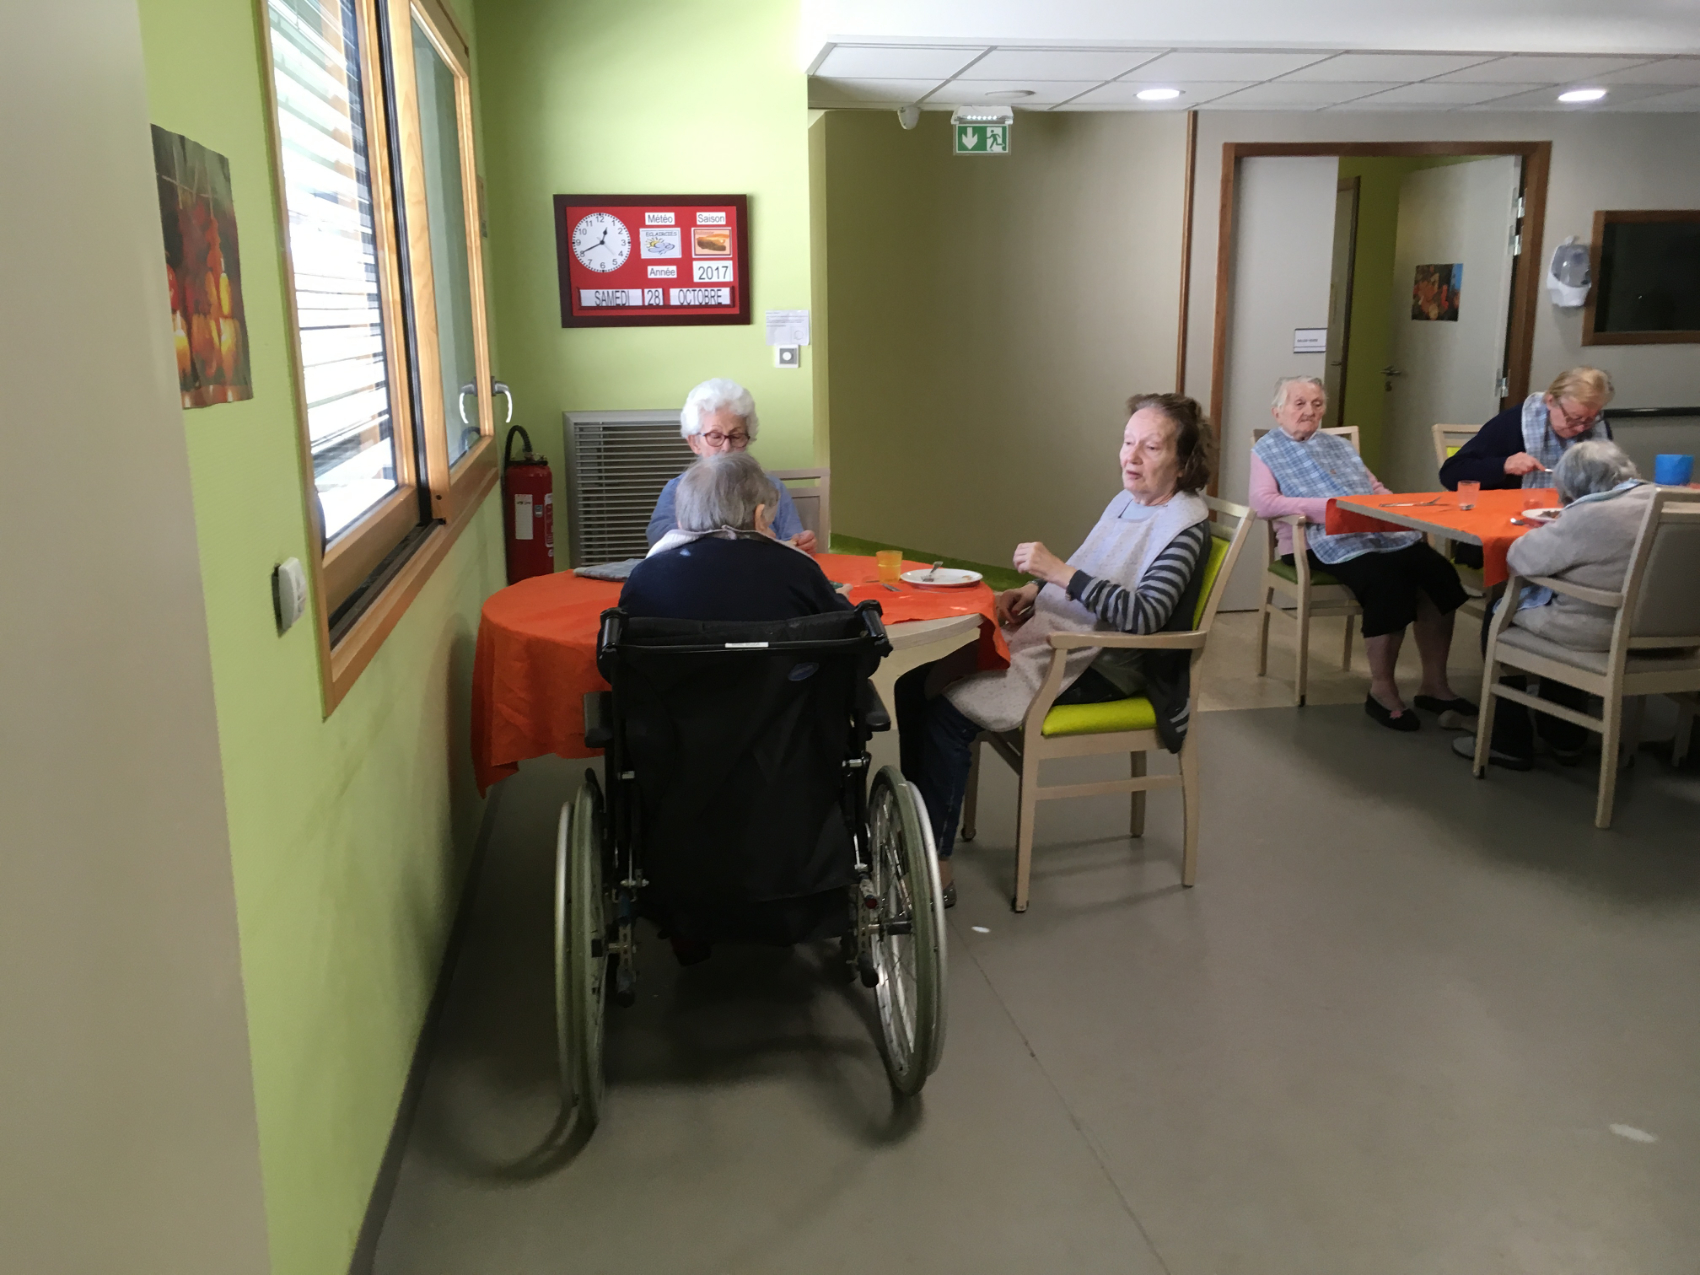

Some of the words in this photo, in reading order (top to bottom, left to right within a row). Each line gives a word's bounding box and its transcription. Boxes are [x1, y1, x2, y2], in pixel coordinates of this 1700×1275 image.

[595, 215, 605, 223] 12
[647, 213, 673, 224] Météo
[697, 213, 725, 223] Saison
[617, 227, 623, 235] 2
[575, 239, 581, 247] 9
[620, 239, 626, 247] 3
[579, 250, 586, 258] 8
[599, 261, 606, 269] 6
[612, 258, 618, 266] 5
[649, 267, 676, 277] Année
[697, 265, 729, 281] 2017
[594, 290, 630, 306] SAMEDI
[646, 289, 661, 306] 28
[677, 288, 722, 306] OCTOBRE
